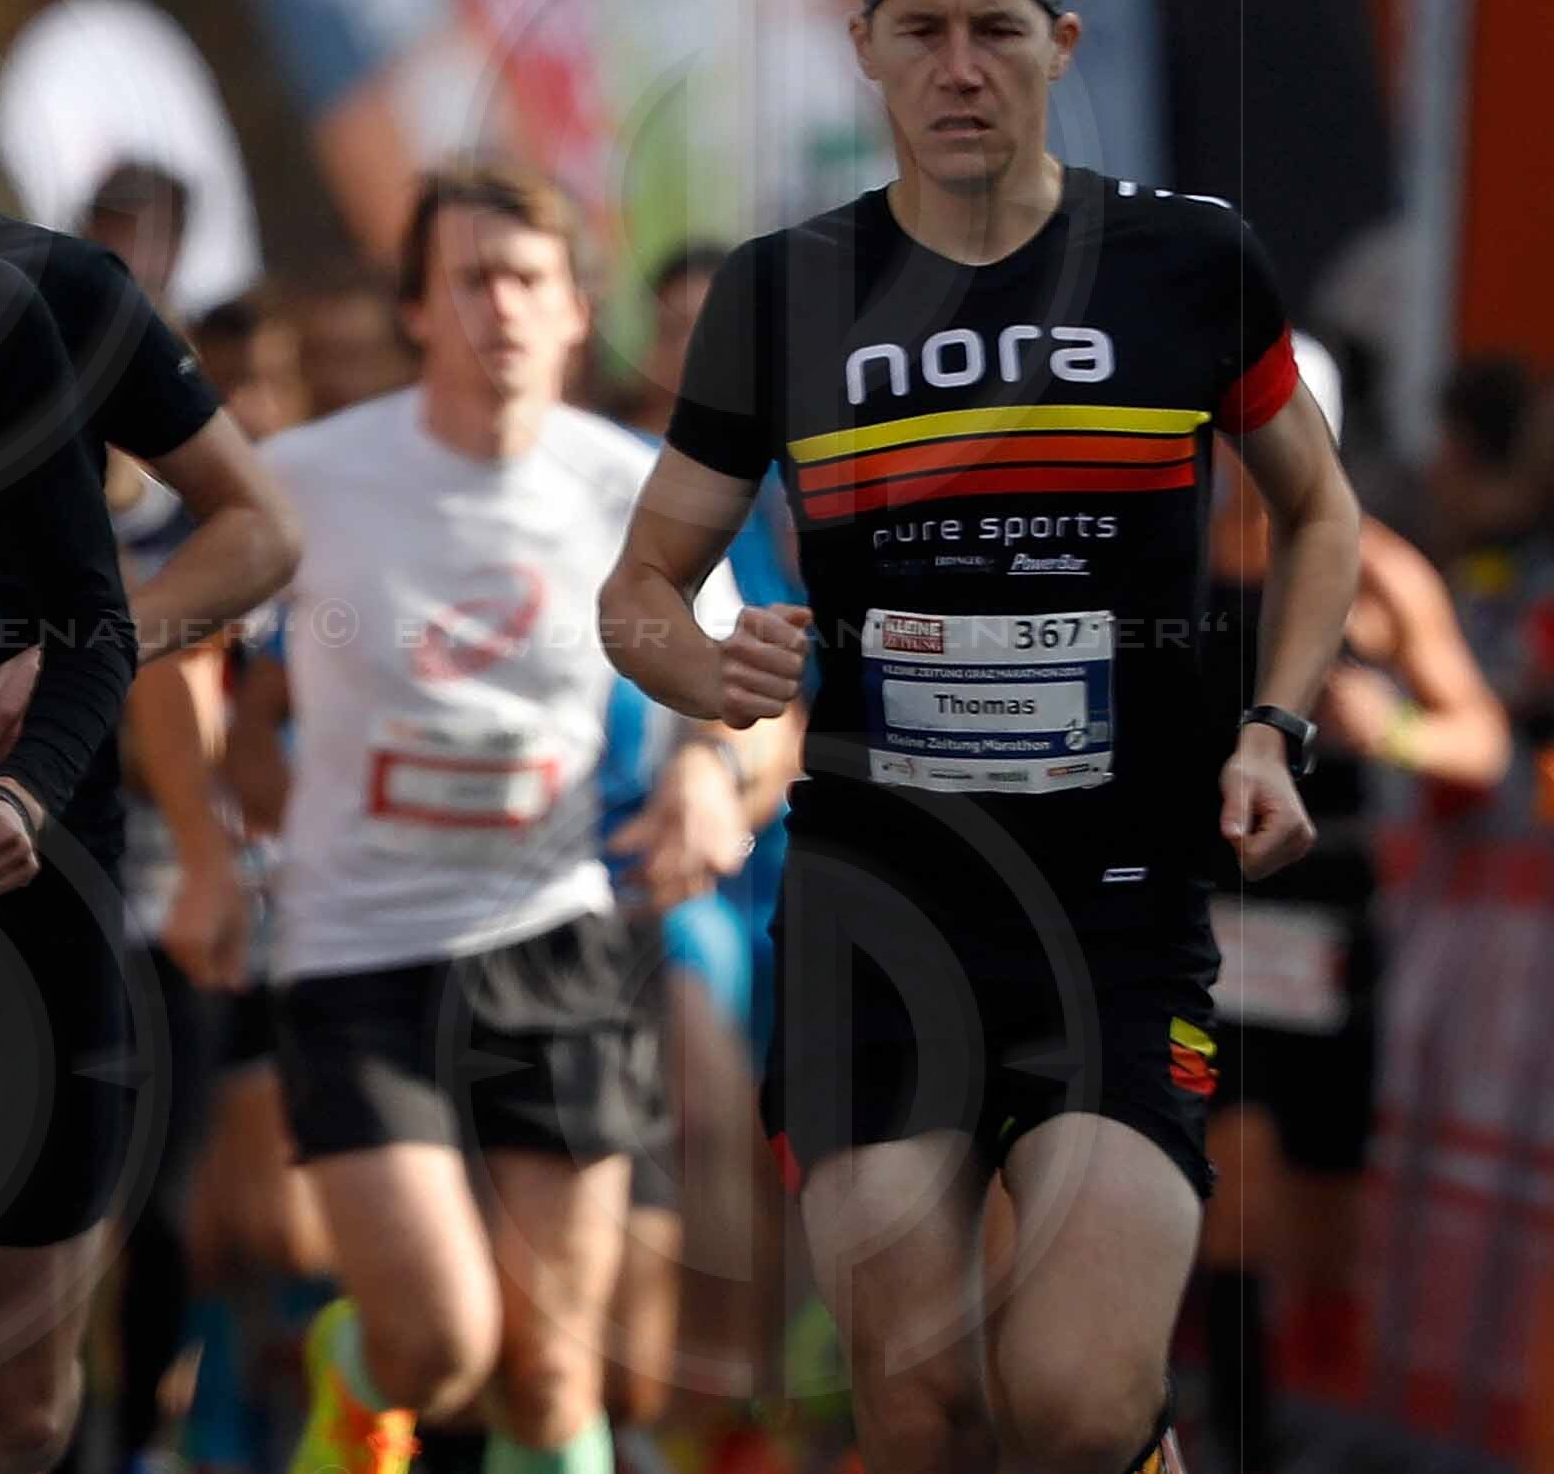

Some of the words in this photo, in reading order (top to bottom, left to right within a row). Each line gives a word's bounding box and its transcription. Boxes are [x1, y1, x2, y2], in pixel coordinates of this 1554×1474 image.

[845, 324, 1115, 405] nora
[873, 519, 963, 549] pure
[978, 513, 1119, 547] sports
[1014, 618, 1082, 650] 367
[934, 694, 1035, 716] Thomas
[926, 736, 981, 754] Zeitung
